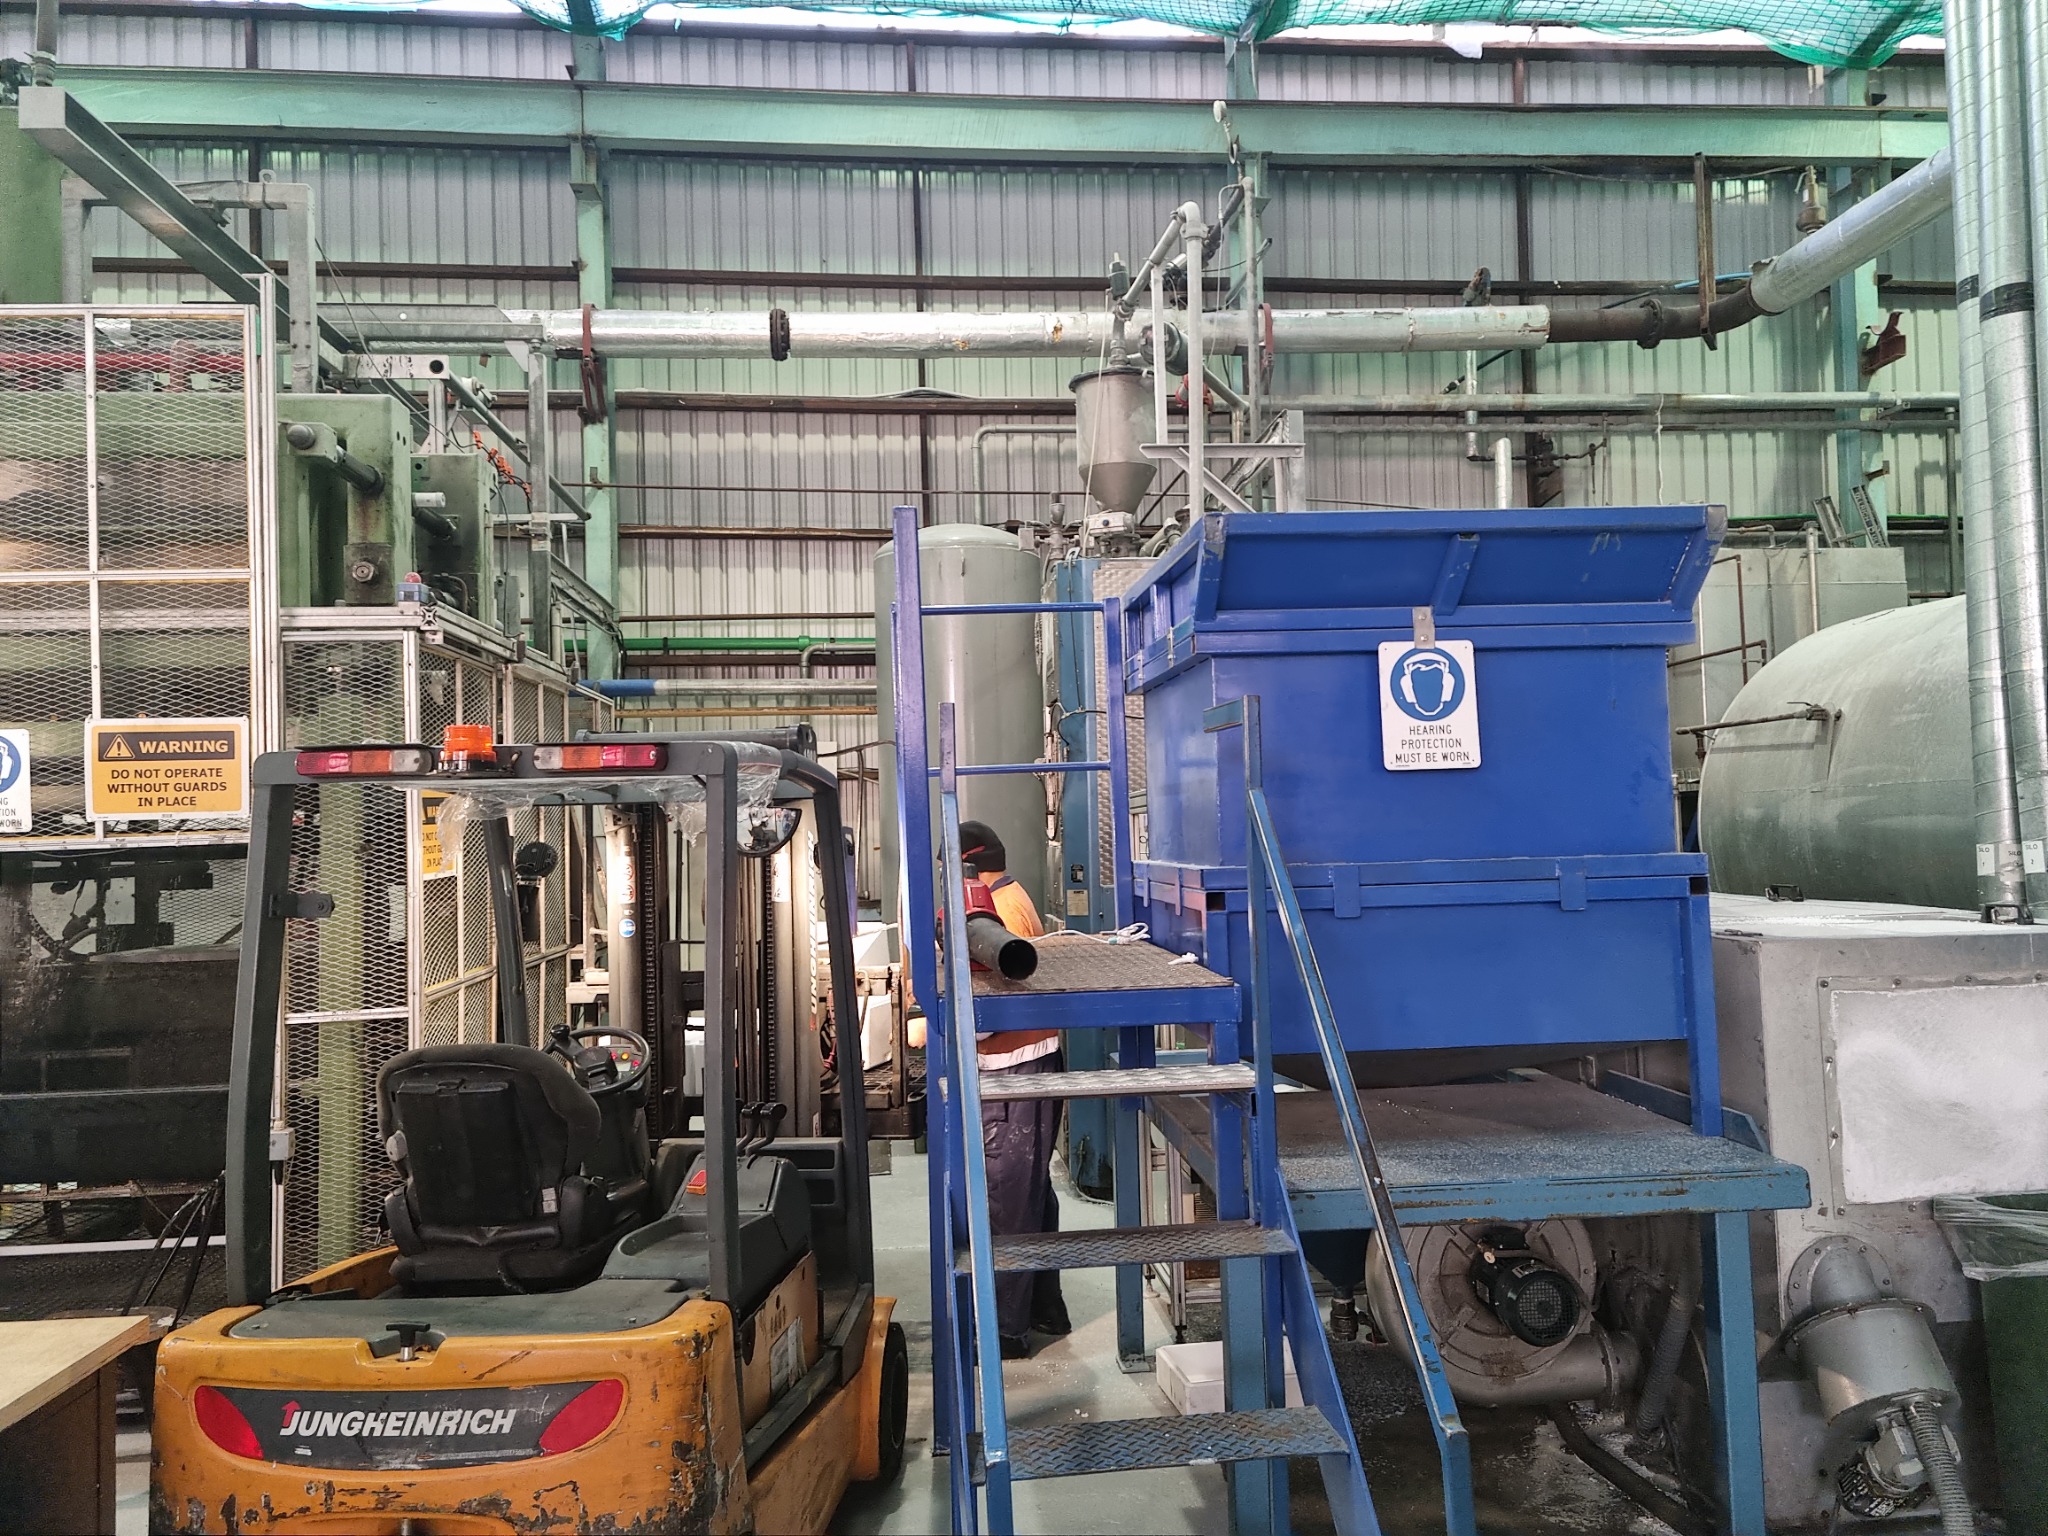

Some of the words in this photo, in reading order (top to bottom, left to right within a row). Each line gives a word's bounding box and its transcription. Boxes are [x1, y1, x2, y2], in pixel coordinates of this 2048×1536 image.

[1409, 725, 1452, 735] HEARING
[138, 740, 229, 754] WARNING
[1401, 738, 1462, 749] PROTECTION
[1395, 752, 1421, 763] MUST
[1425, 752, 1438, 763] BE
[1441, 751, 1470, 762] WORN
[111, 769, 130, 779] DO
[134, 768, 161, 779] NOT
[164, 768, 223, 778] OPERATE
[107, 783, 170, 793] WITHOUT
[173, 782, 227, 792] GUARDS
[138, 797, 152, 807] IN
[157, 796, 197, 806] PLACE
[808, 831, 817, 1030] UNGHINRICH
[279, 1408, 517, 1438] JUNGHEINRICH
